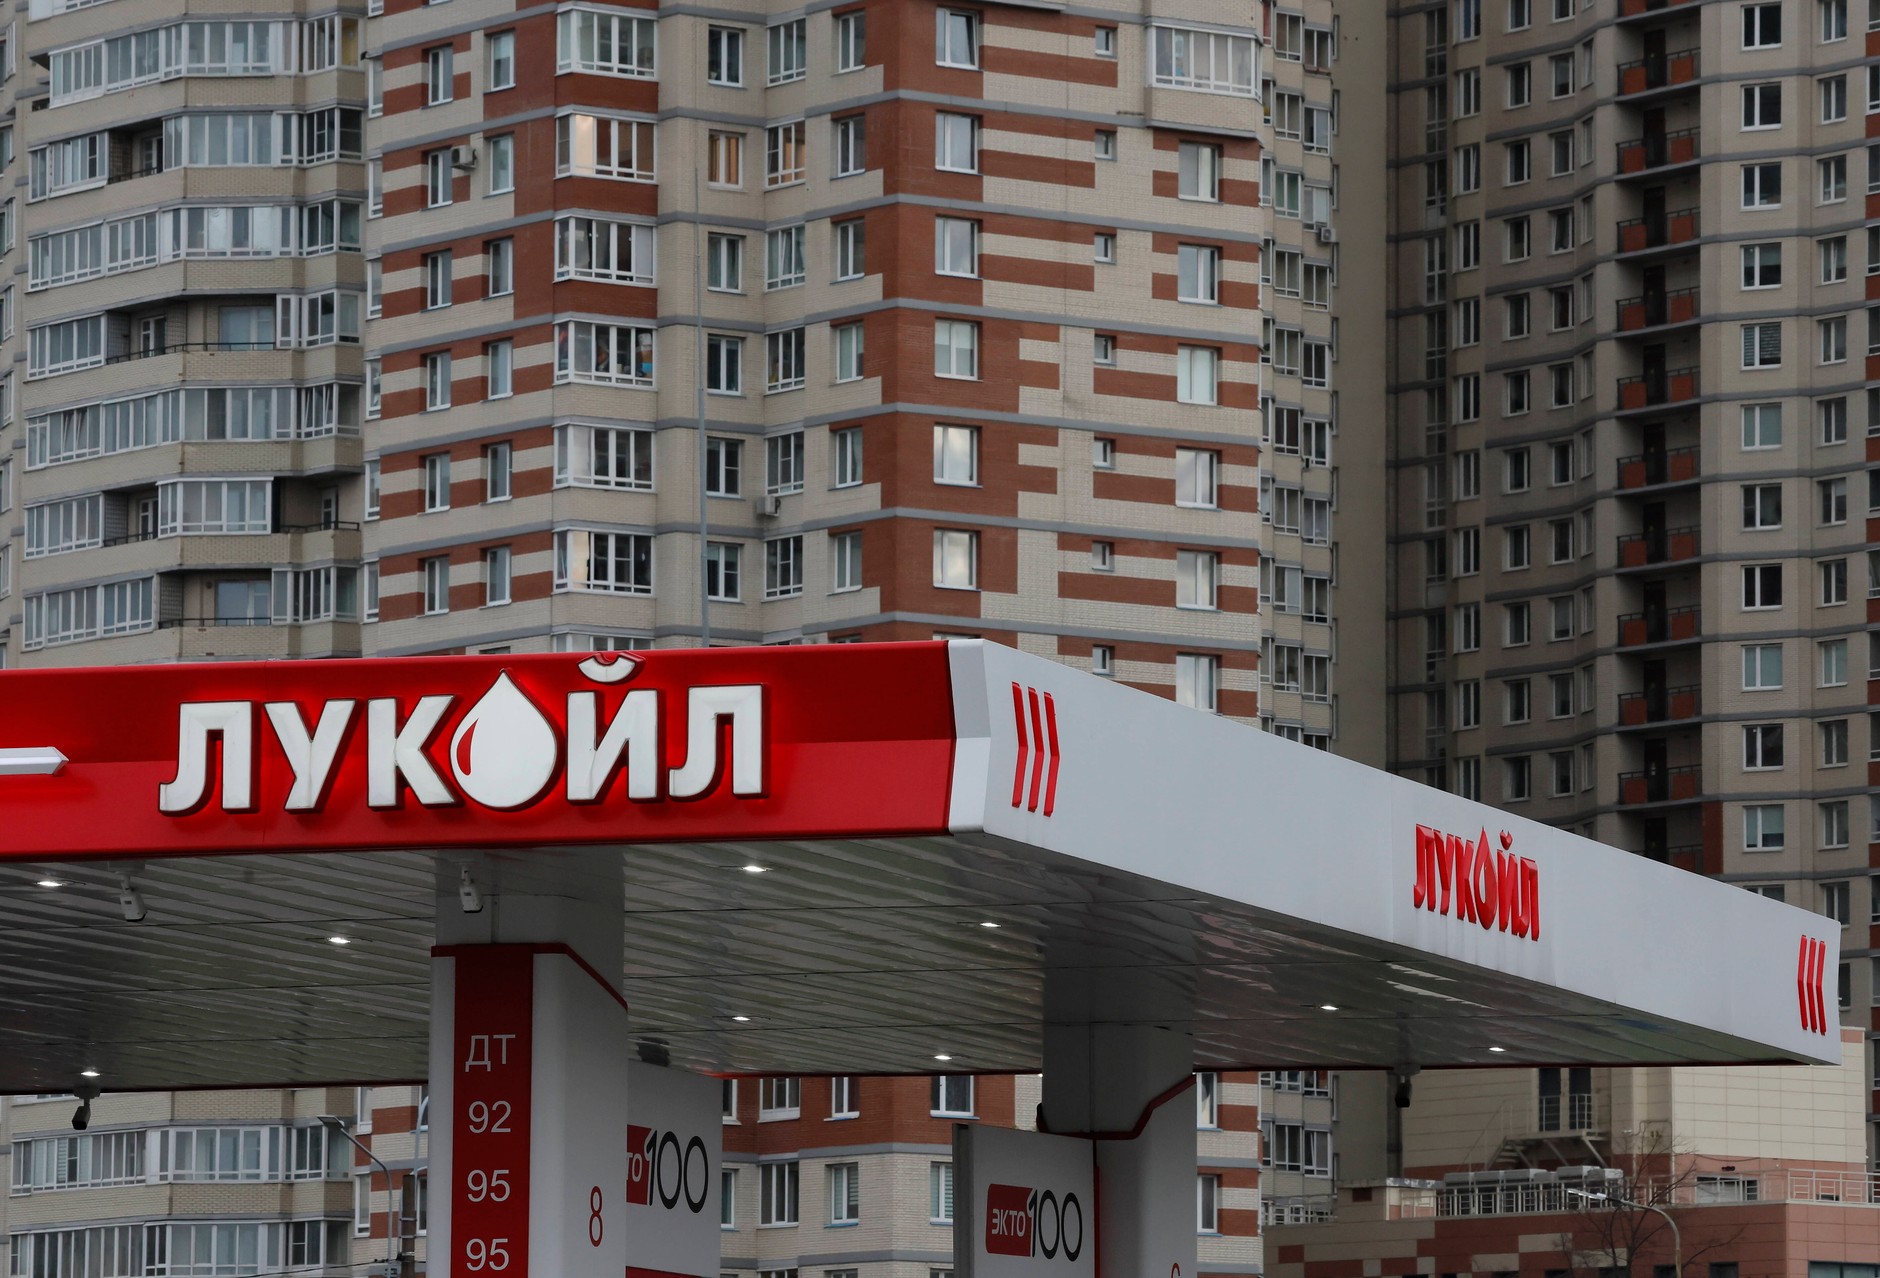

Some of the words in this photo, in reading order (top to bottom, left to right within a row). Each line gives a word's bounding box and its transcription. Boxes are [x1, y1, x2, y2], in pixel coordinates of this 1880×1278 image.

[159, 652, 767, 814] ЛУКОЙЛ
[1413, 823, 1540, 942] ЛУКОЙЛ
[465, 1034, 516, 1072] ДТ
[468, 1100, 511, 1134] 92
[467, 1169, 511, 1203] 95
[627, 1151, 642, 1183] ТО
[646, 1130, 709, 1213] 100
[589, 1185, 603, 1247] 8
[991, 1208, 1026, 1238] ЭКТО
[1027, 1189, 1083, 1262] 100
[466, 1238, 509, 1271] 95
